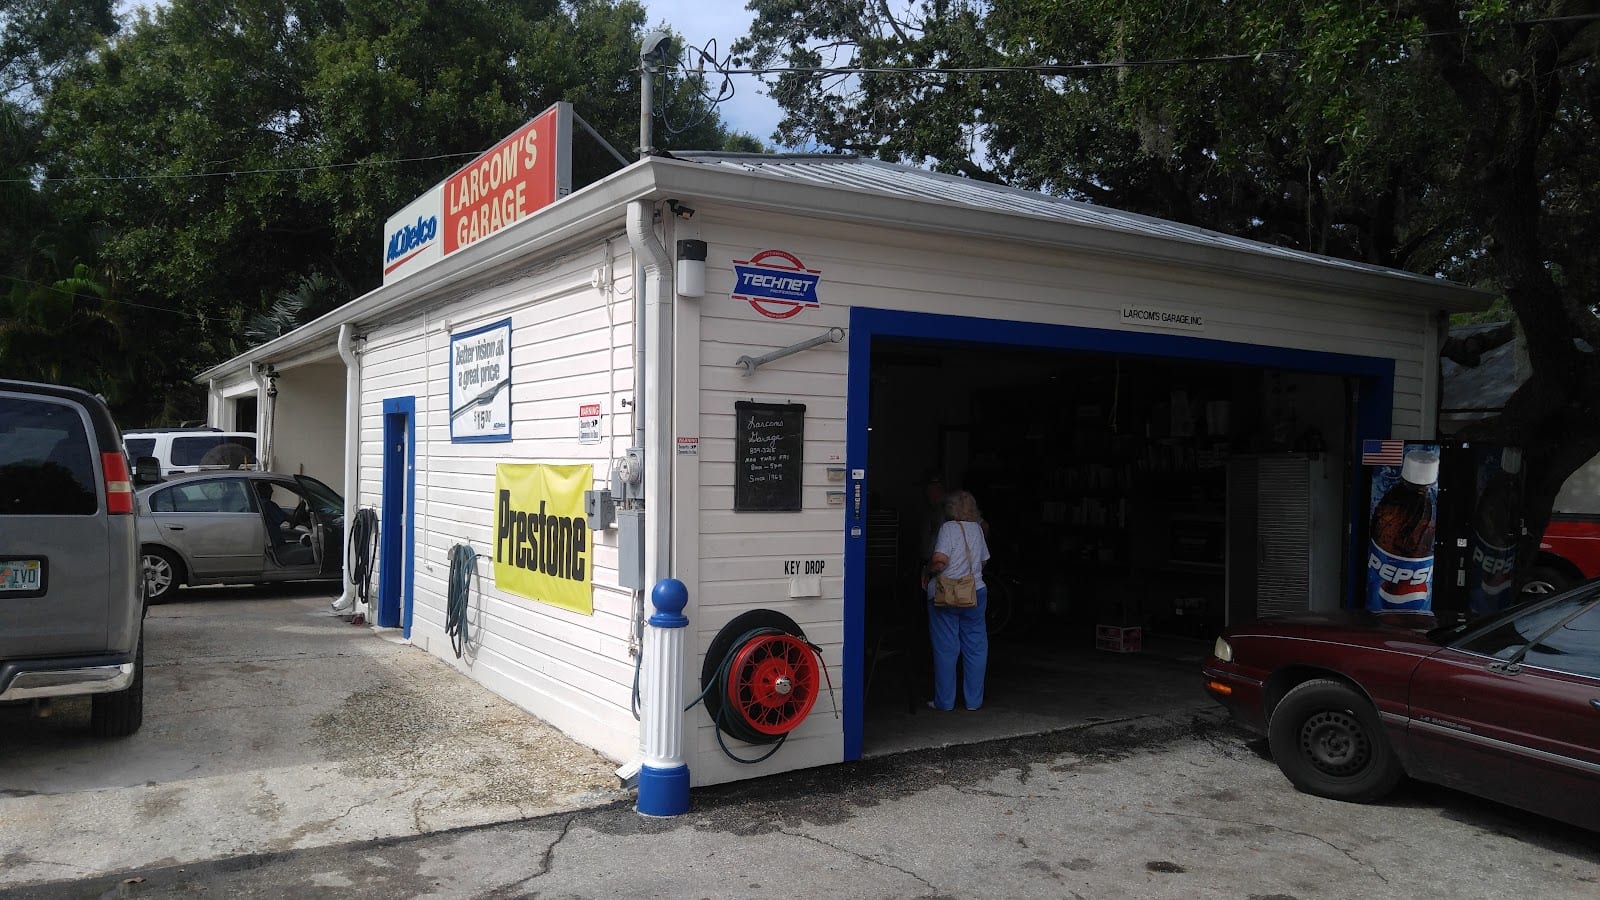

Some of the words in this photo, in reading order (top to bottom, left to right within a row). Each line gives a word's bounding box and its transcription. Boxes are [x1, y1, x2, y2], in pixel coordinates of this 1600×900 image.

[450, 129, 538, 216] LARCOM'S
[387, 215, 437, 263] ACDelco
[456, 181, 527, 249] GARAGE
[455, 345, 475, 366] Better
[474, 338, 496, 362] vision
[495, 335, 505, 357] at
[458, 371, 463, 387] a
[462, 363, 480, 391] great
[480, 360, 500, 388] price
[497, 489, 586, 582] Prestone
[784, 560, 800, 576] KEY
[805, 560, 825, 575] DROP
